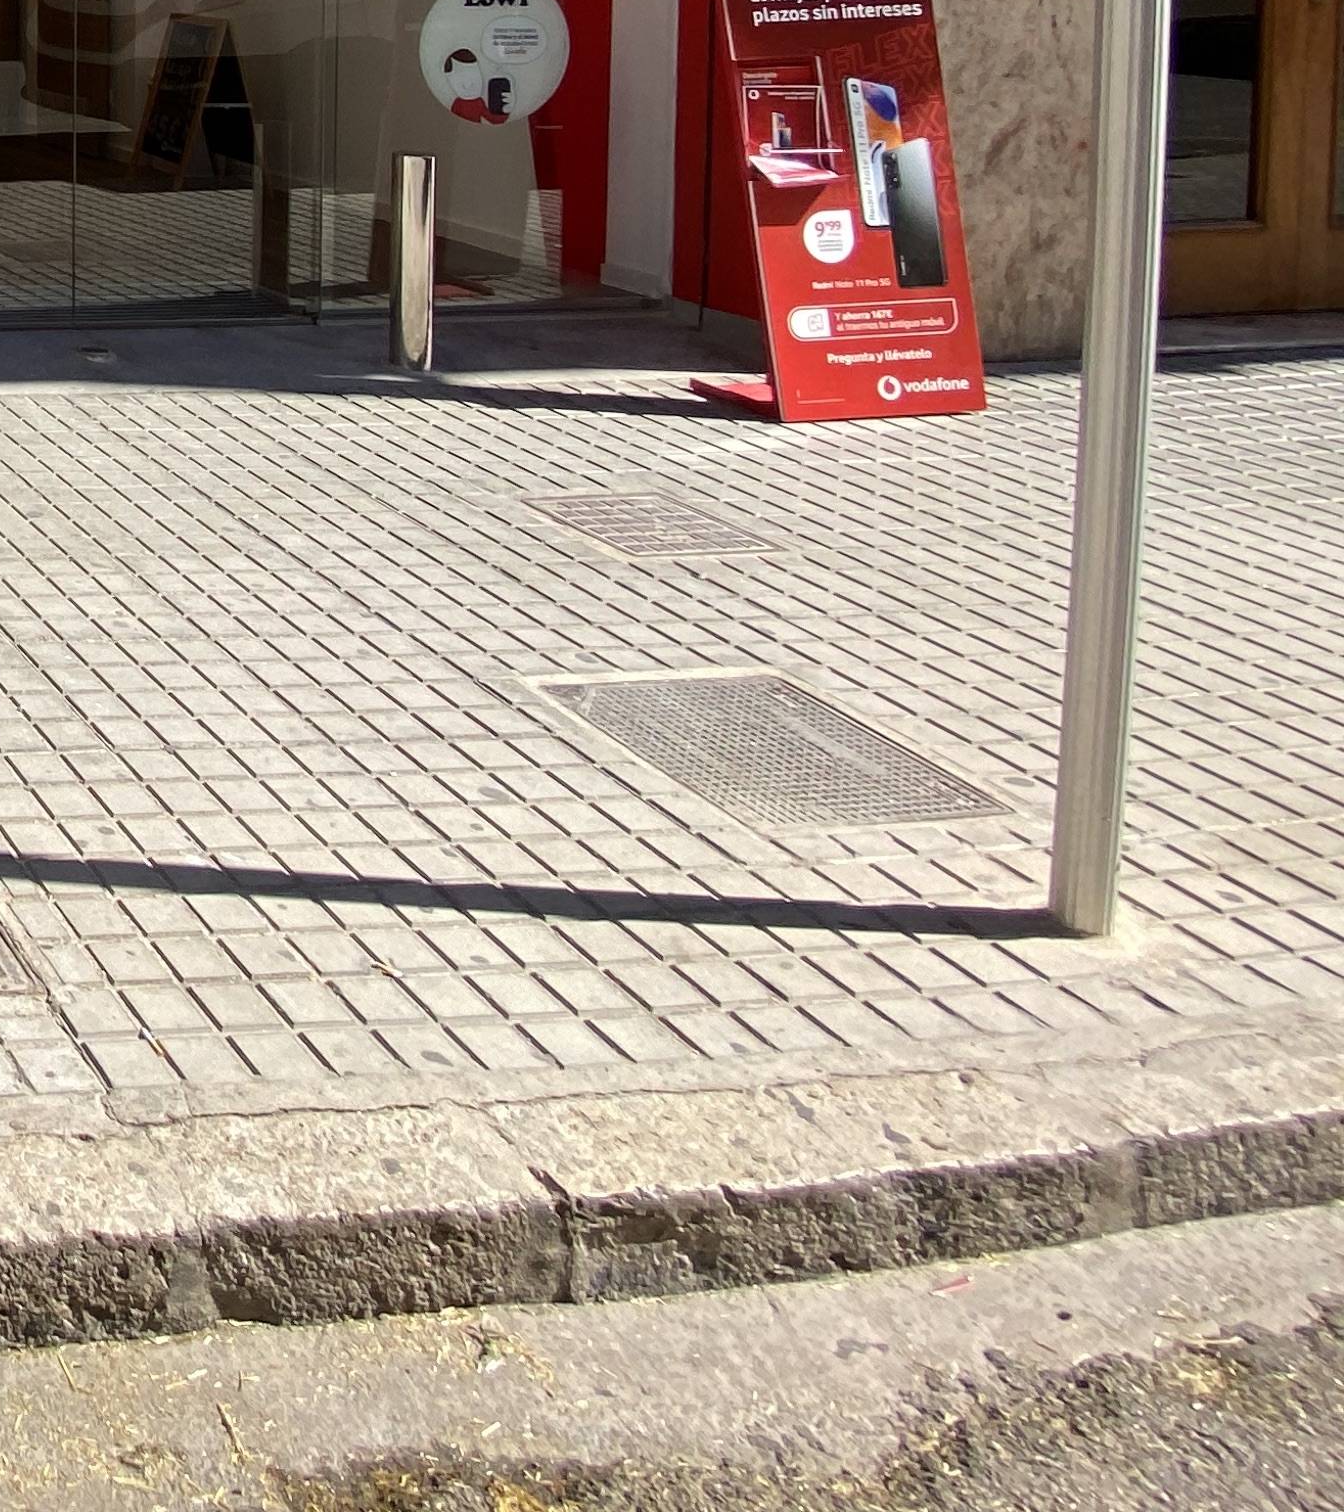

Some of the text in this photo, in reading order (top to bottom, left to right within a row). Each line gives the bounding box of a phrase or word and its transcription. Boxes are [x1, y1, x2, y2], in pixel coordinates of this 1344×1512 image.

[752, 2, 923, 27] plazos sin intereses
[826, 353, 875, 365] Pregunta
[876, 352, 884, 363] y
[903, 377, 969, 393] vodafone
